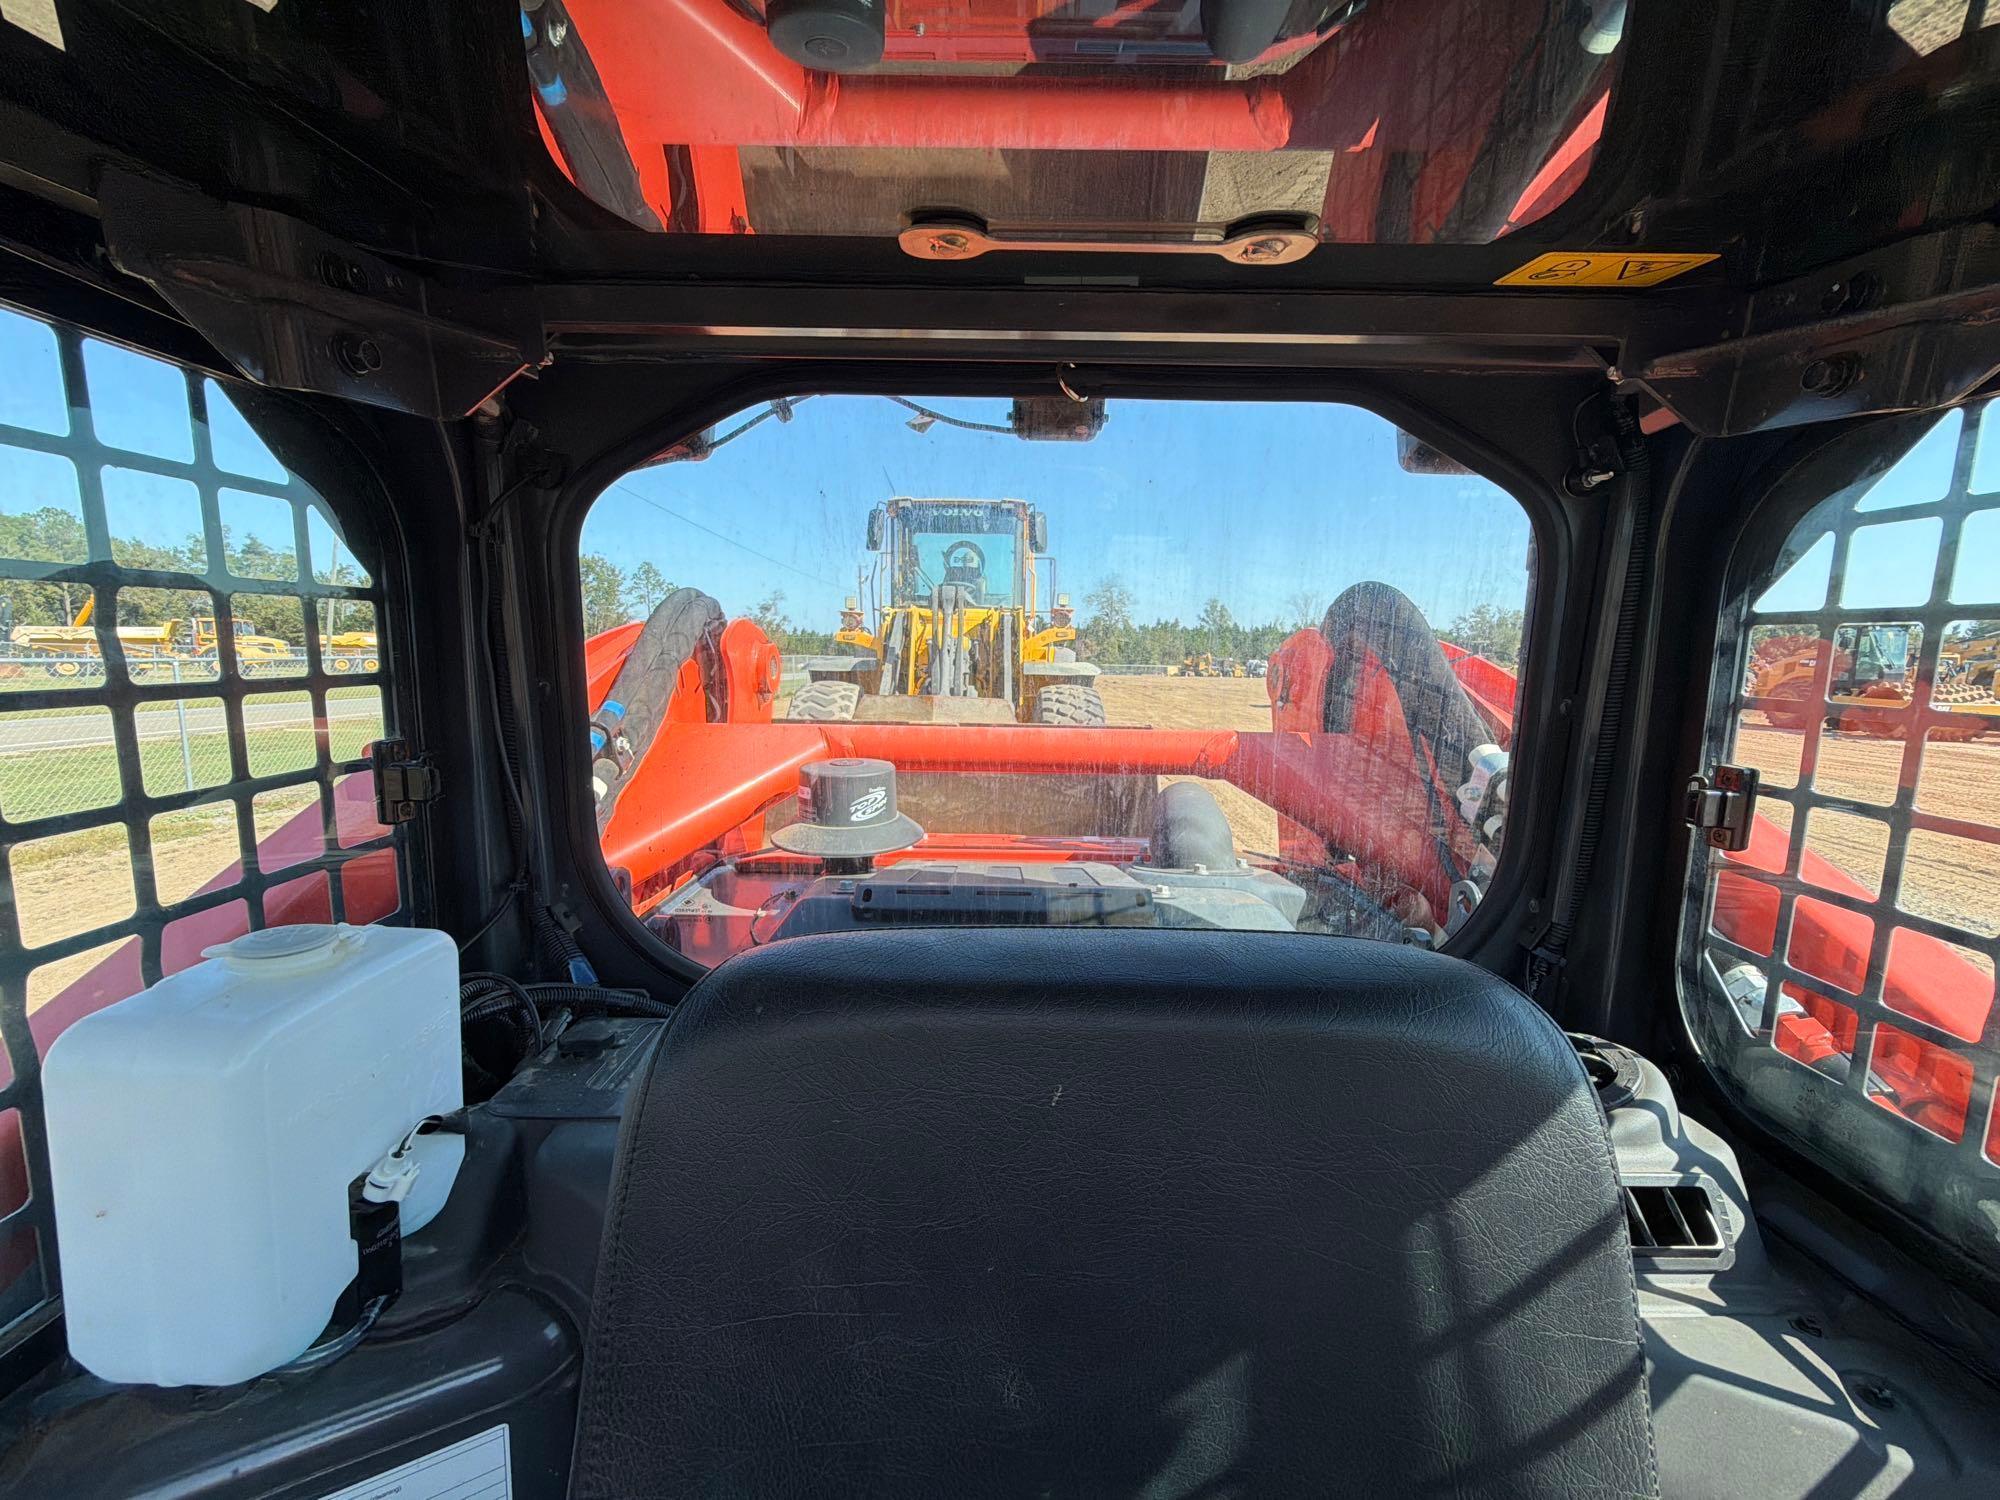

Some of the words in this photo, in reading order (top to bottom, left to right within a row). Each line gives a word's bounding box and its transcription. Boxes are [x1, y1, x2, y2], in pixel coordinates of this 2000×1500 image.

[932, 507, 983, 517] VOLVO
[849, 797, 877, 813] TOP
[865, 797, 888, 815] SPIN
